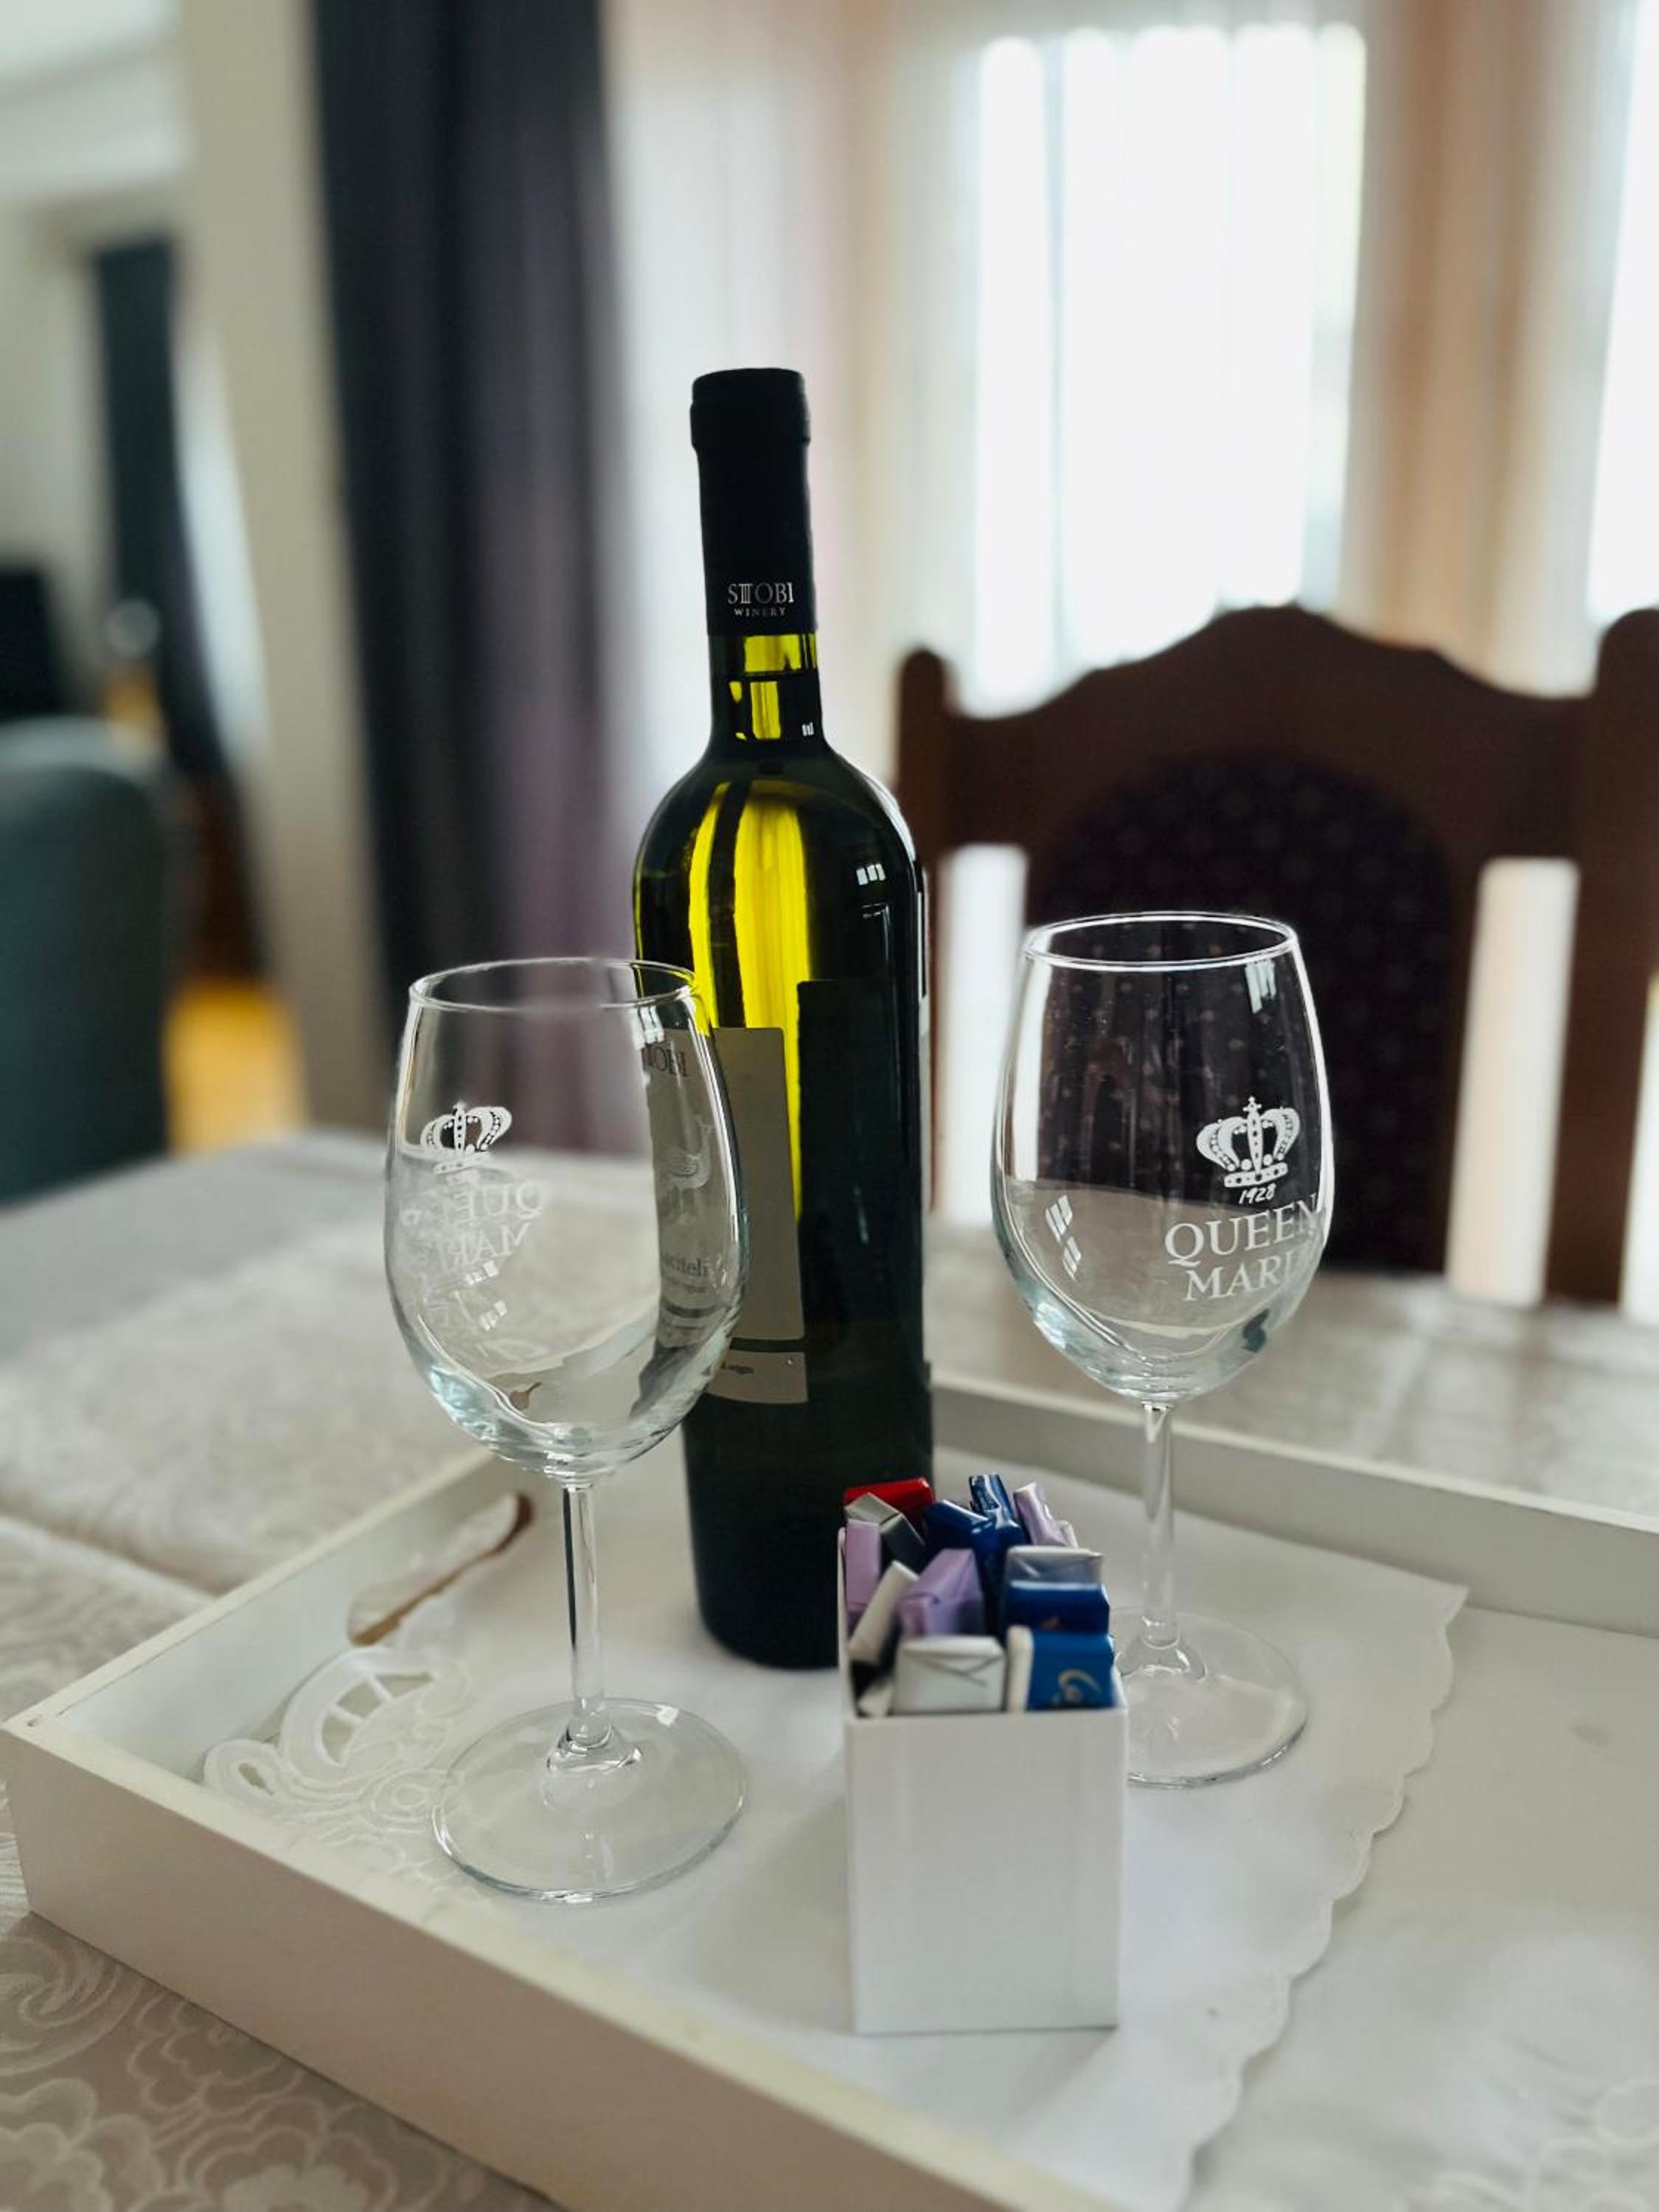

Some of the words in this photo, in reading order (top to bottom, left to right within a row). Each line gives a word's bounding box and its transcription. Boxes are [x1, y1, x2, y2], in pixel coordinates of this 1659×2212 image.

[727, 582, 795, 605] STOBI
[734, 606, 787, 617] WINERY
[1238, 1182, 1277, 1205] 1928
[1164, 1192, 1320, 1268] QUEEN
